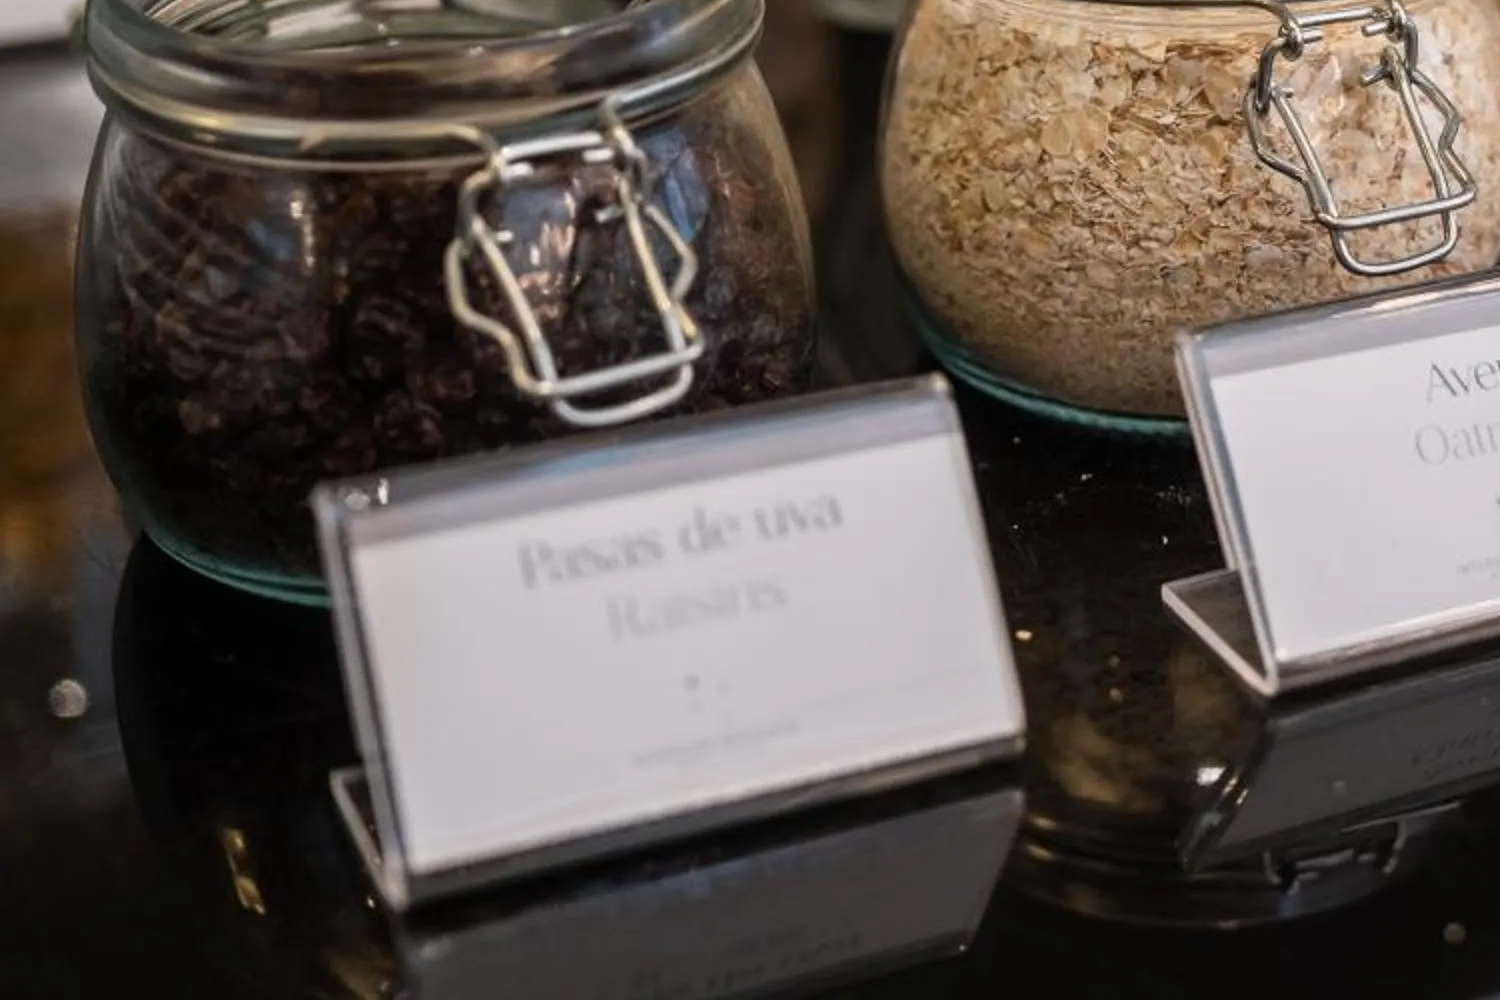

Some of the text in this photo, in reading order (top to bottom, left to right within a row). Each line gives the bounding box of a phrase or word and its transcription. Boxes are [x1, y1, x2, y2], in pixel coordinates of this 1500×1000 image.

[516, 493, 846, 590] Pasas de uva
[601, 573, 790, 646] Raisins
